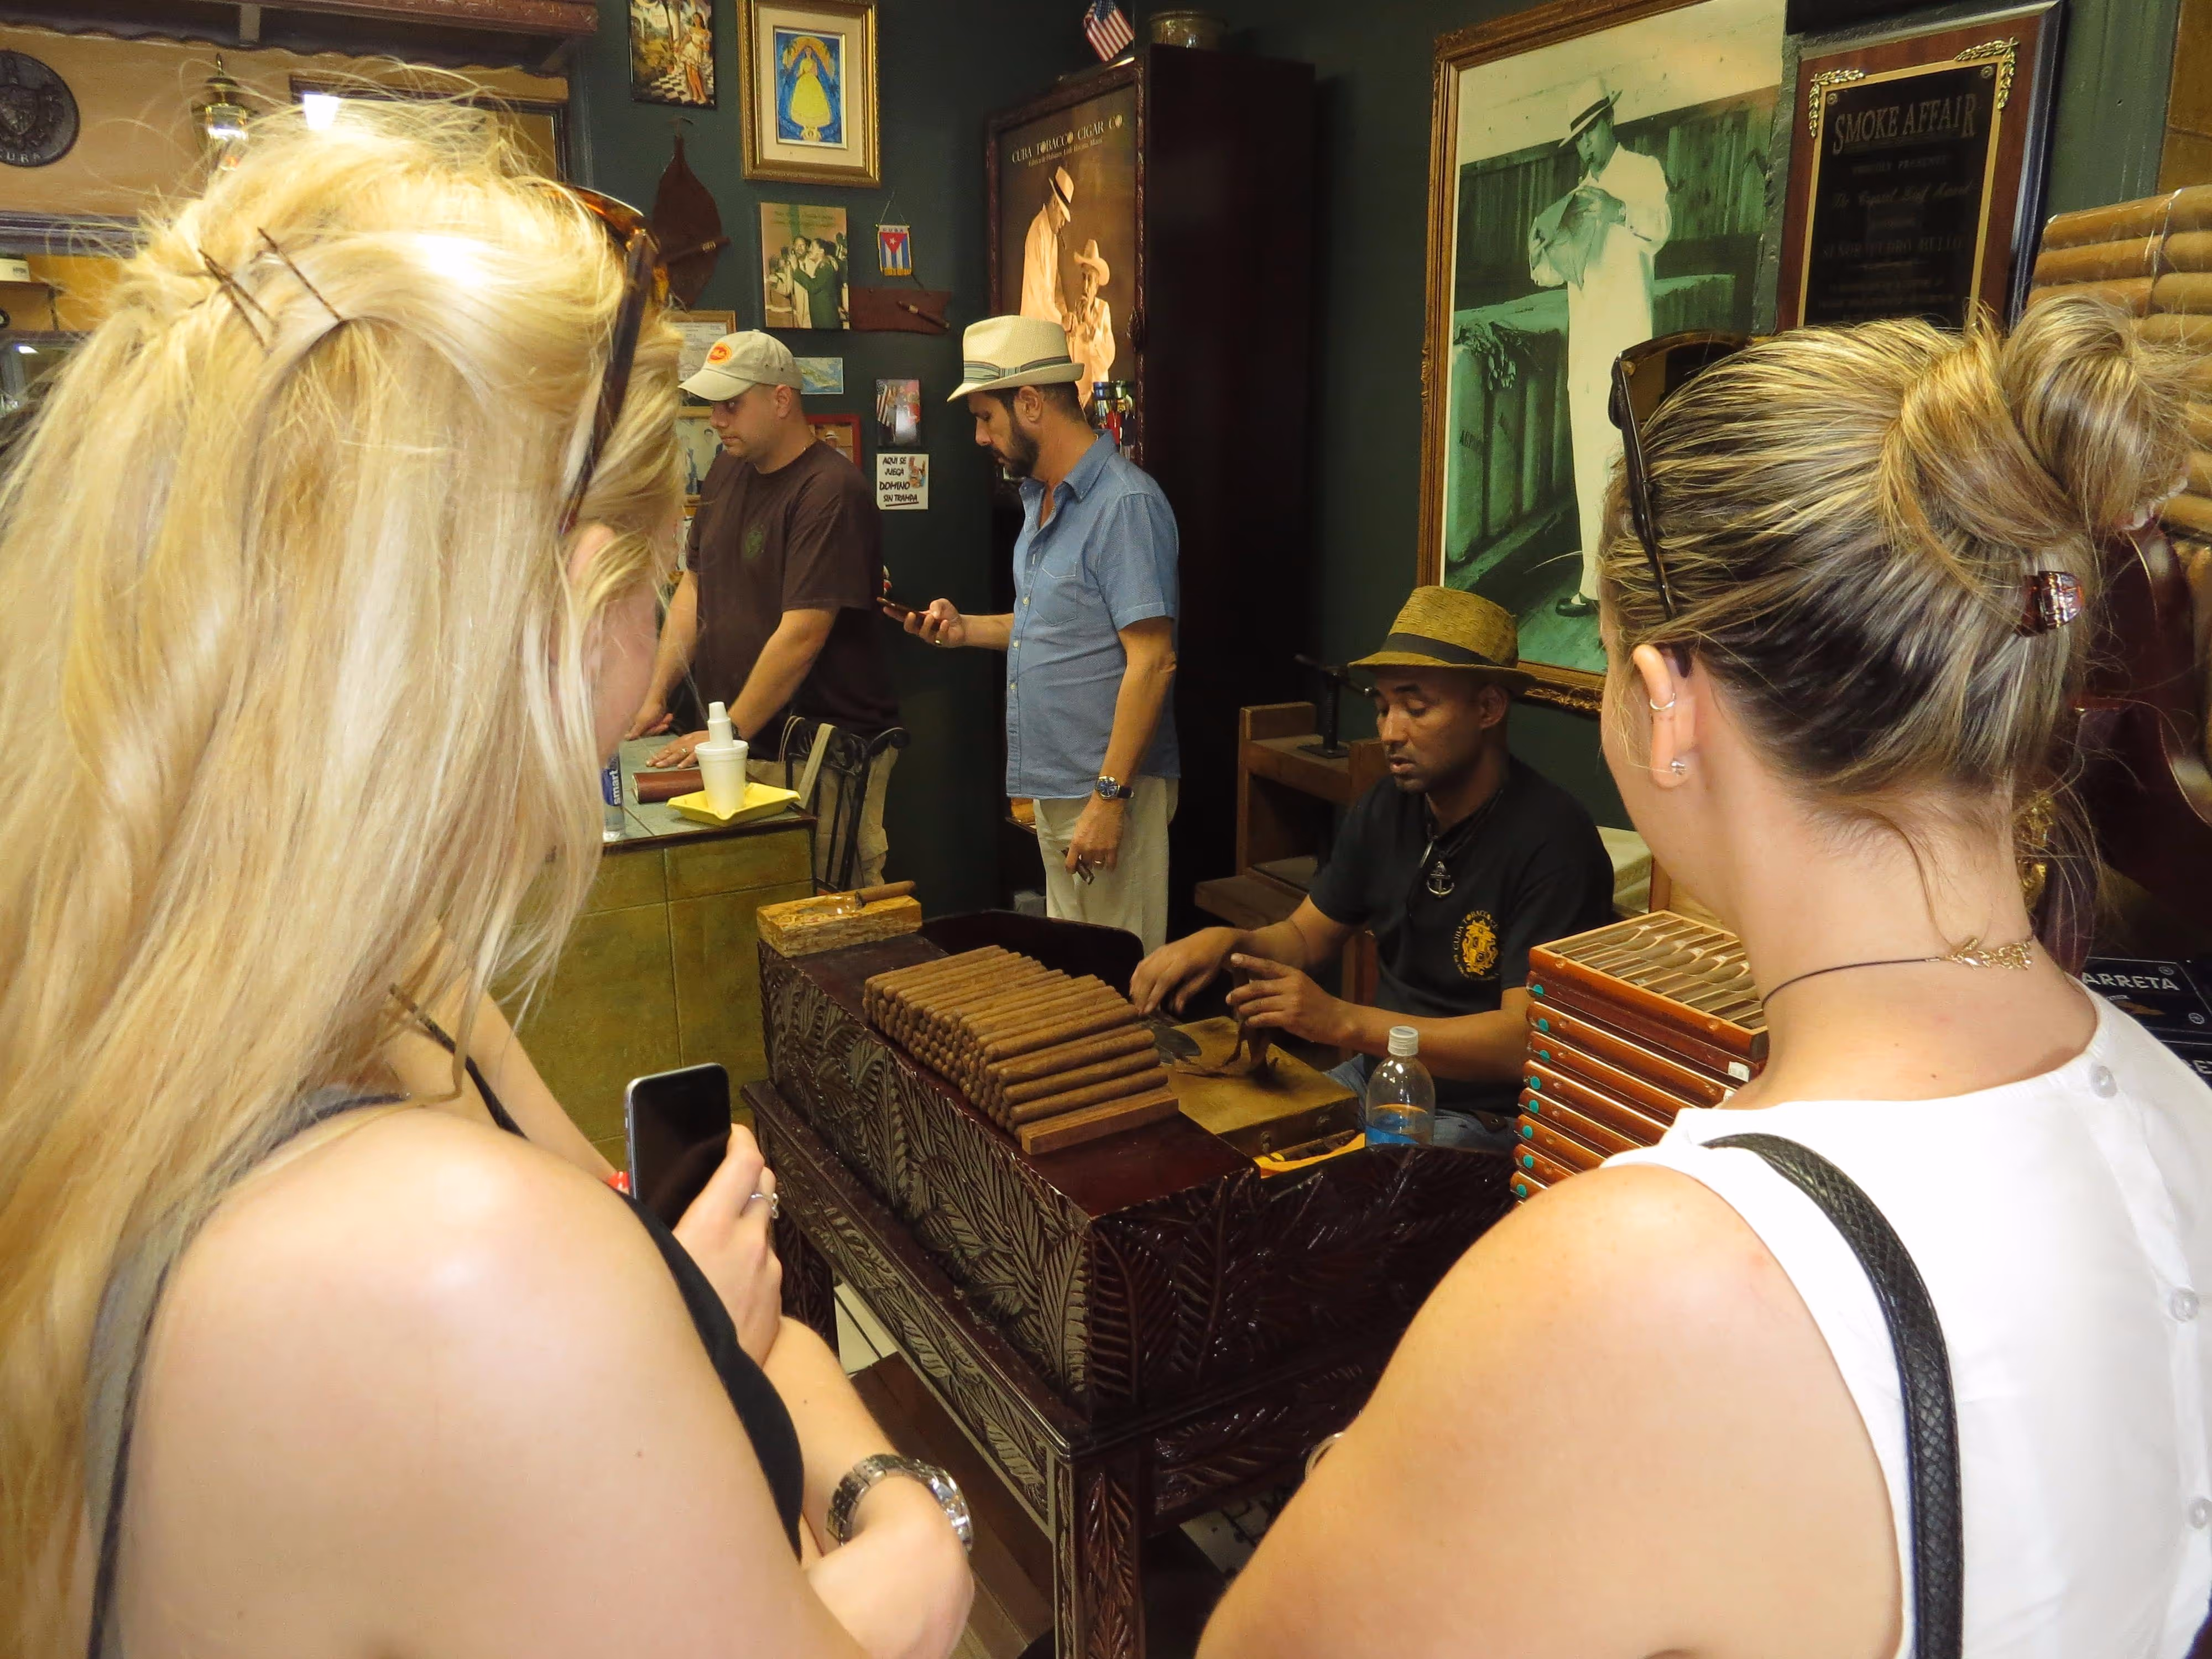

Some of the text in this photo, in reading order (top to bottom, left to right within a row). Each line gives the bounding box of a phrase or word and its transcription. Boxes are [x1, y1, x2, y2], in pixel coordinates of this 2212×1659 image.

[1832, 93, 1977, 155] SMOKE AFFAIR
[1011, 114, 1123, 163] CUBA TOBACCO CIGAR CO
[883, 456, 898, 466] AQUI
[885, 467, 904, 476] JUEGA
[879, 481, 910, 491] DOMINO
[883, 493, 917, 502] SIN TRAMPA
[609, 770, 620, 805] smart
[1453, 910, 1491, 951] CUBA TOBACCO
